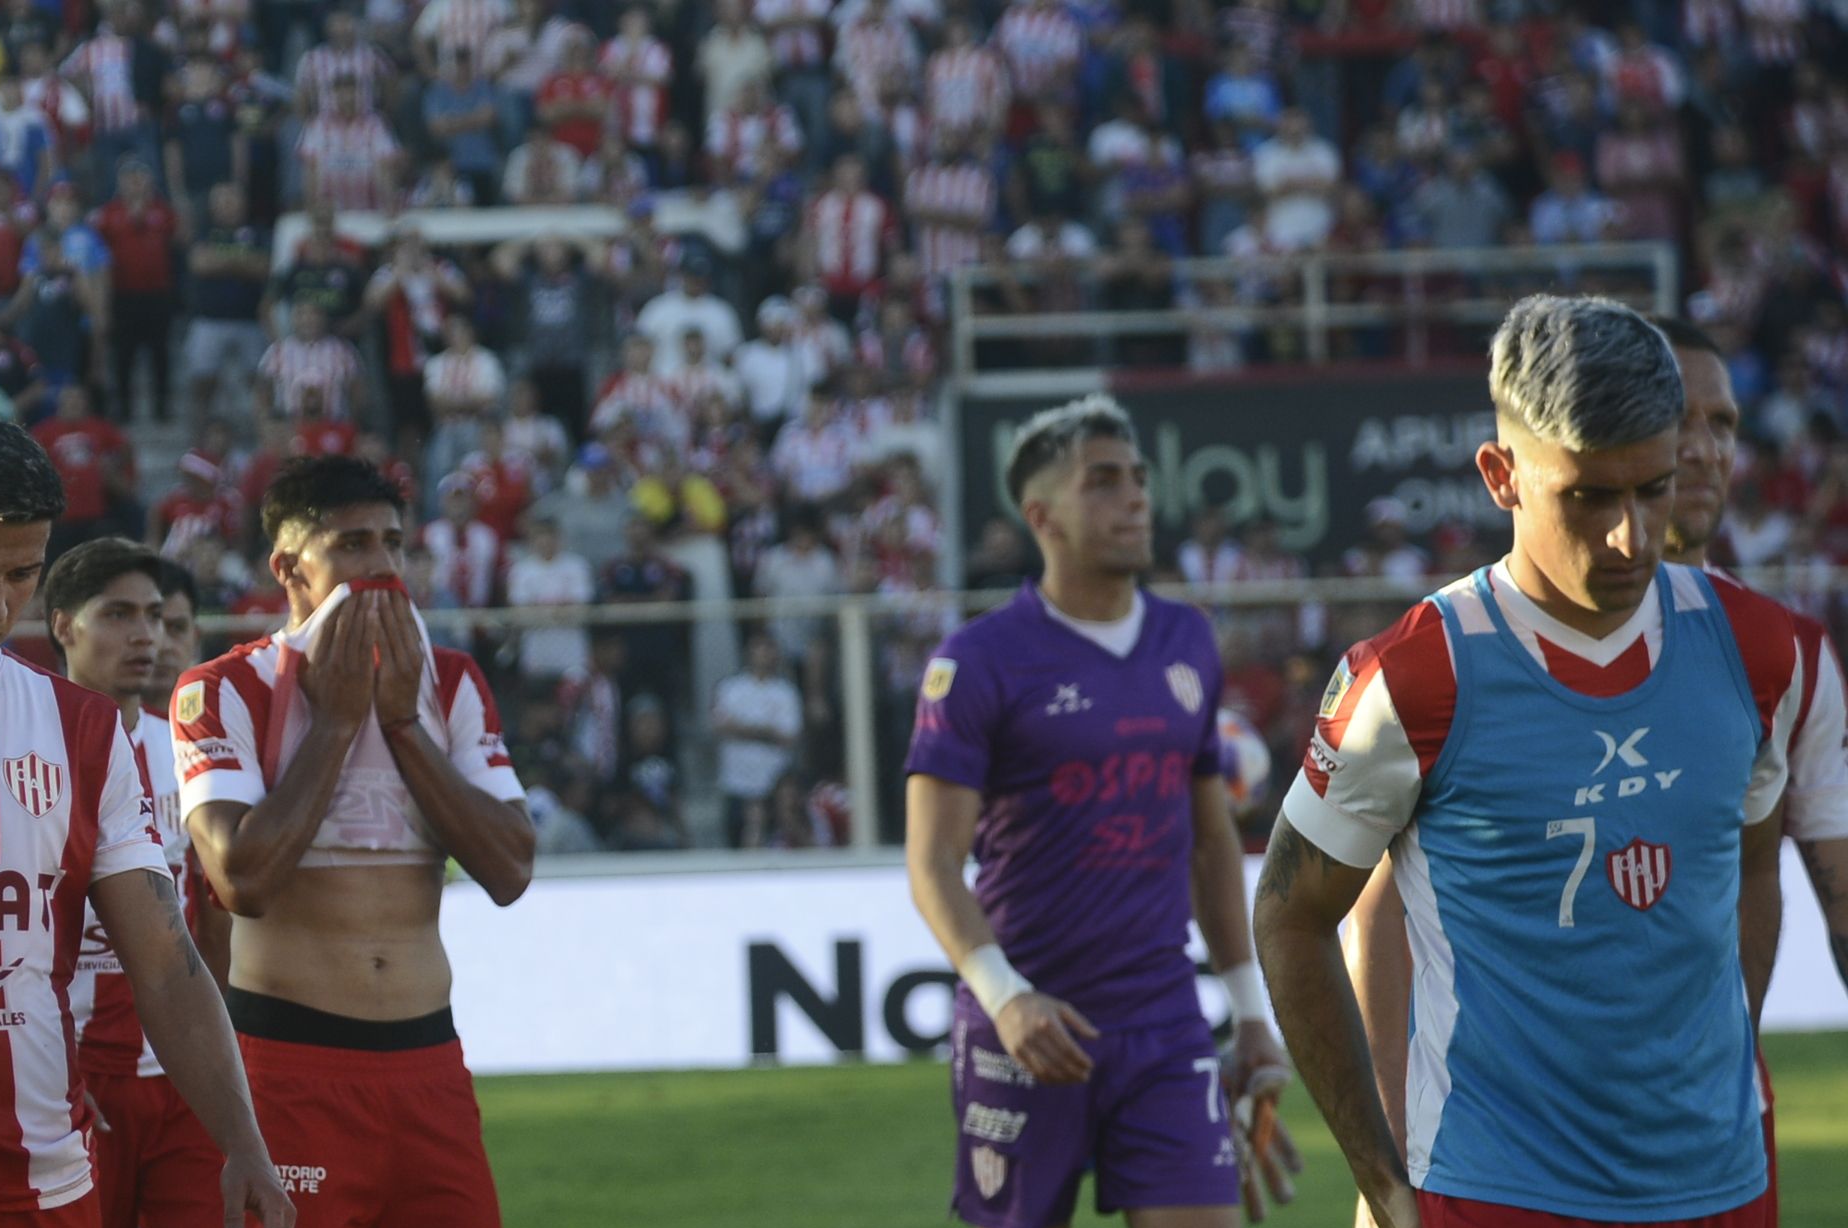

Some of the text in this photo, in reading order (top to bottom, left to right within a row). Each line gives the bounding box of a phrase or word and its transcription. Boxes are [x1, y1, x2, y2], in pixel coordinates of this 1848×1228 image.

[1049, 752, 1194, 806] OSPA
[1574, 769, 1682, 806] KDY
[1546, 817, 1596, 928] 7
[1193, 1056, 1226, 1123] 7
